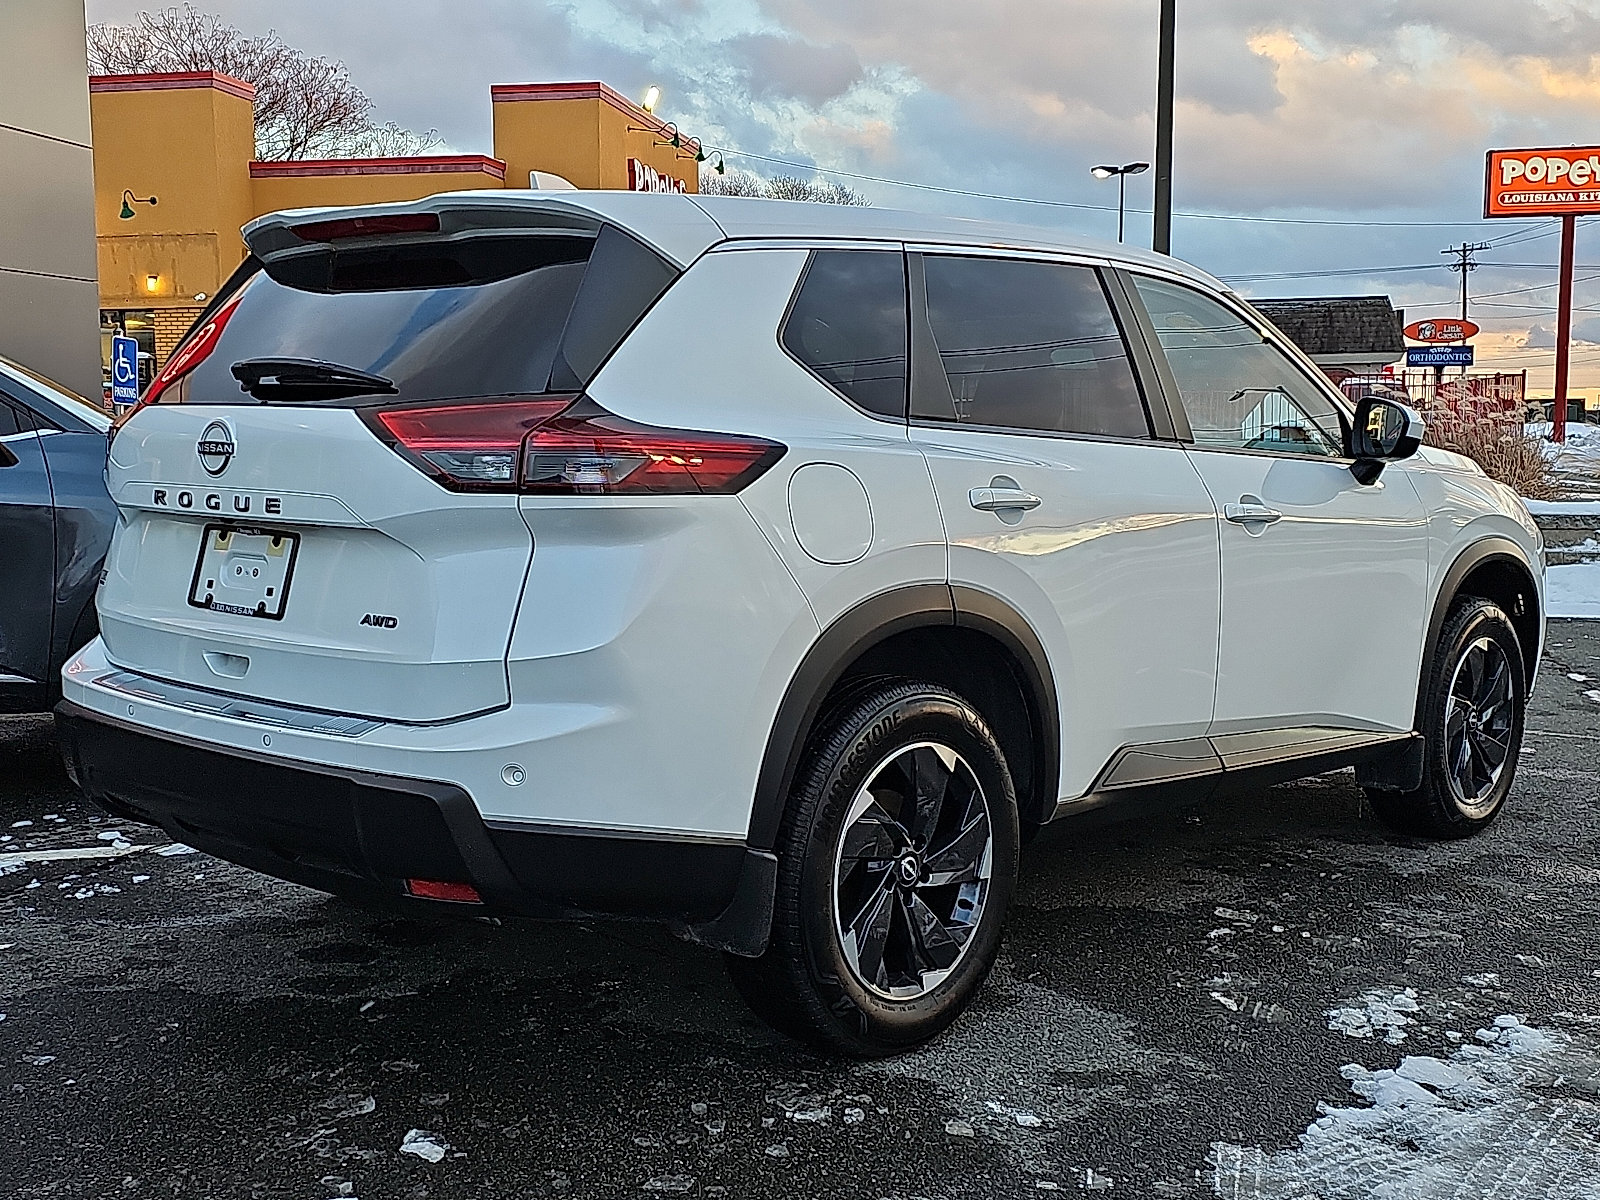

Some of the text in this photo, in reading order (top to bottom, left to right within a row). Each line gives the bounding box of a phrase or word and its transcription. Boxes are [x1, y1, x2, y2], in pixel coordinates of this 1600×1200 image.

[1503, 192, 1575, 203] LOUISIANA
[1443, 324, 1462, 332] Little
[1409, 353, 1472, 361] ORTHODONTICS
[197, 443, 233, 453] NISSAN
[153, 489, 283, 515] ROGUE
[225, 605, 254, 616] NISSAN
[359, 613, 399, 629] AWD
